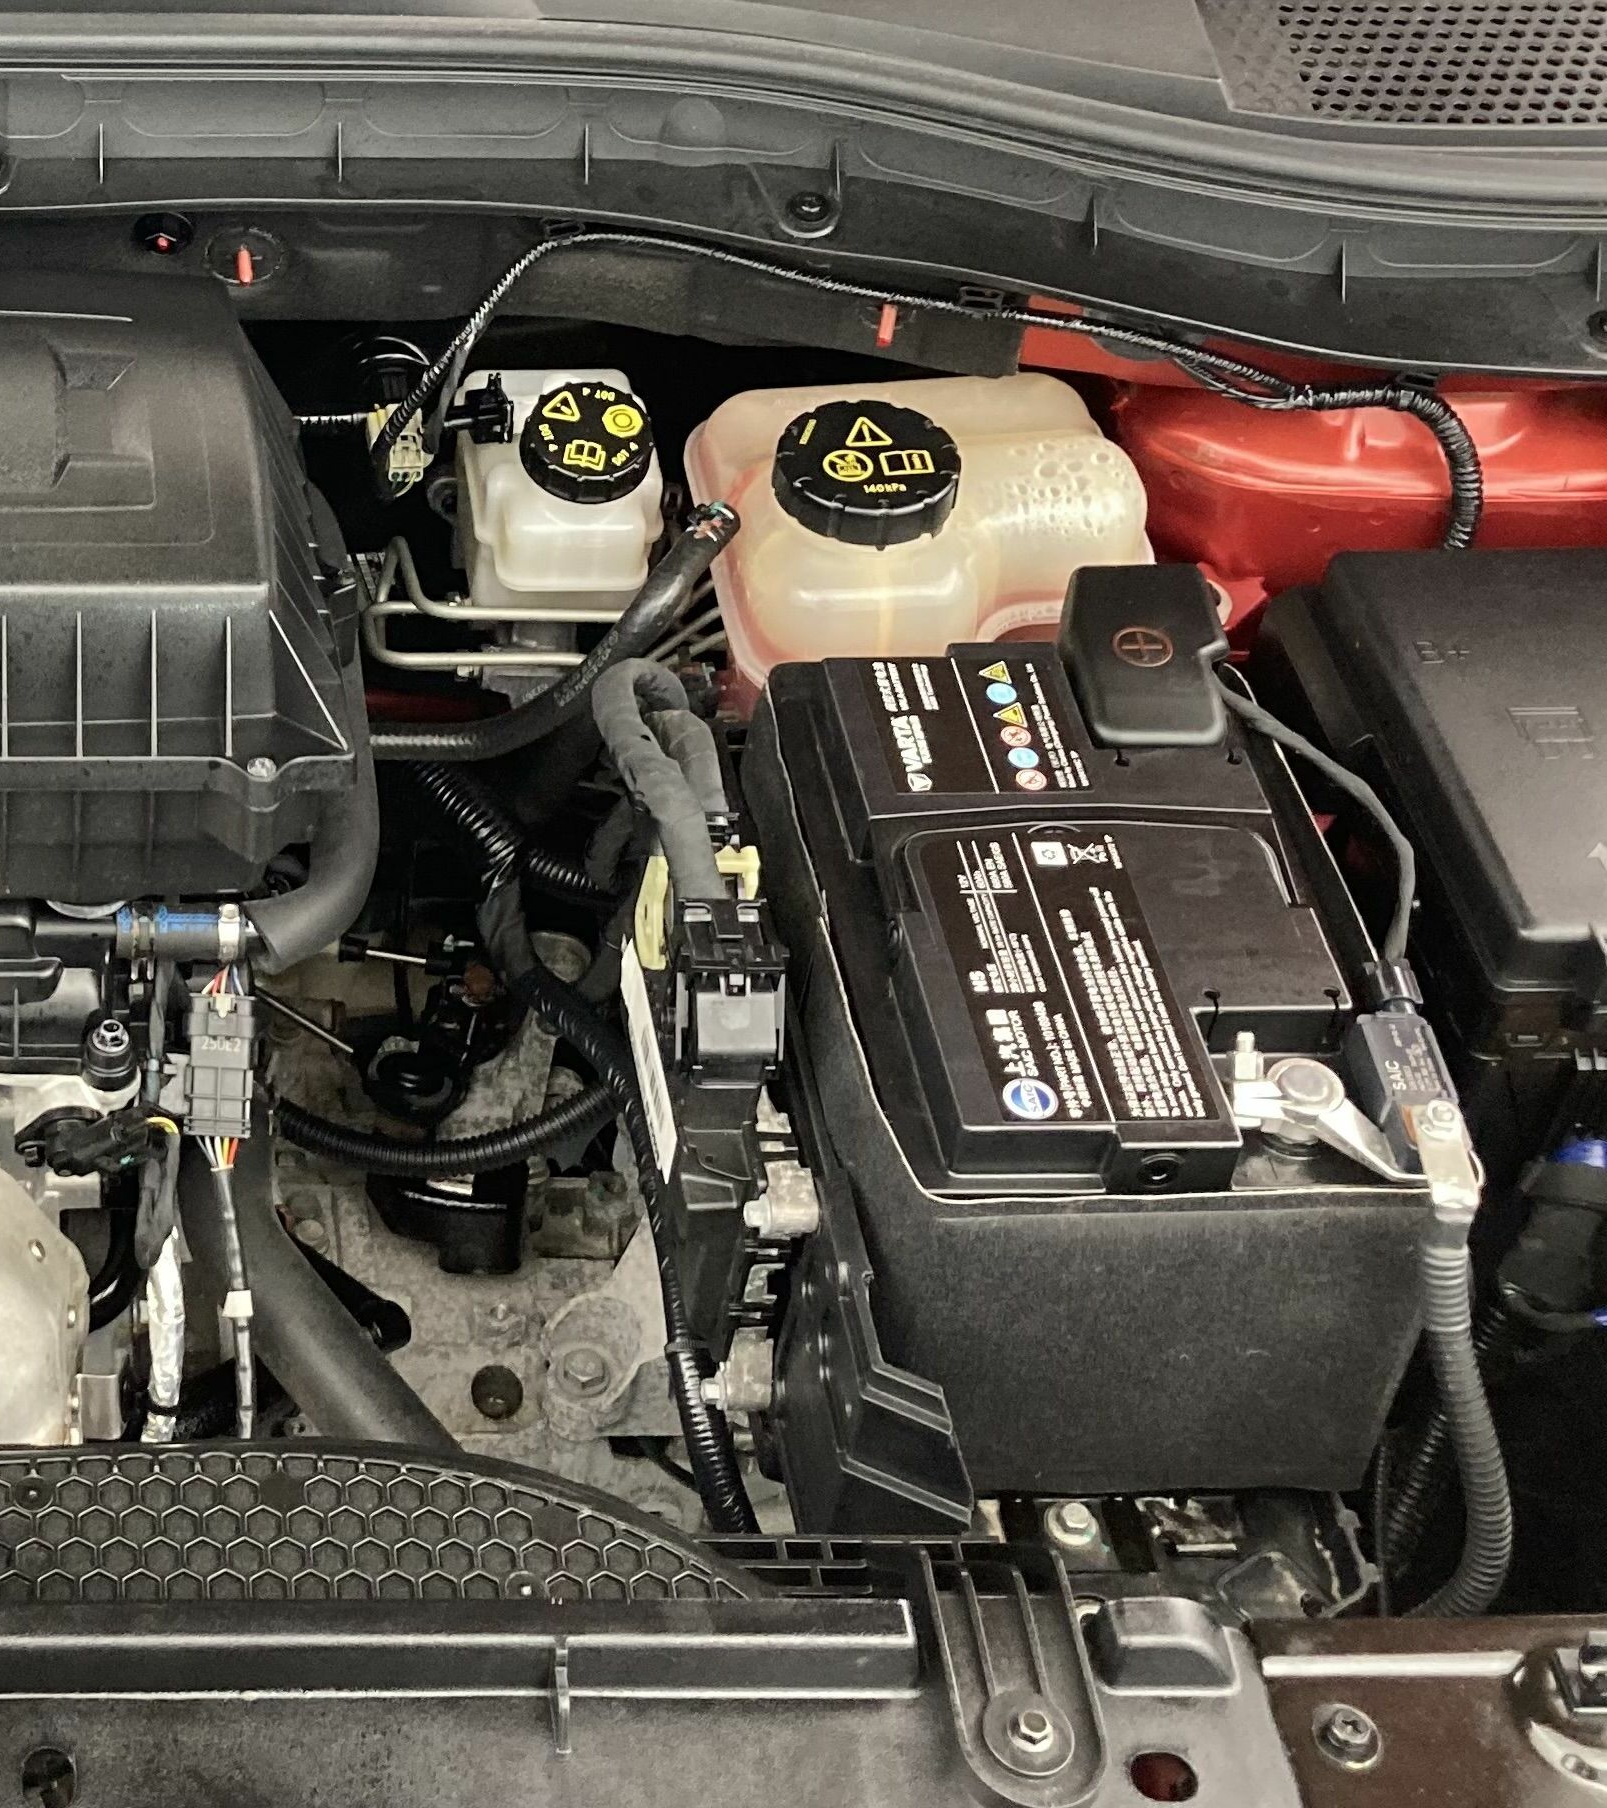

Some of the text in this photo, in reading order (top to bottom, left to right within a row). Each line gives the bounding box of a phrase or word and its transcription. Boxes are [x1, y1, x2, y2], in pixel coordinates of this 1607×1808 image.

[890, 715, 923, 772] VARTA
[1007, 1010, 1030, 1048] MOTOR
[1021, 1049, 1039, 1076] SAIC
[1385, 1060, 1407, 1091] SAIC
[1021, 1083, 1040, 1112] SAIC
